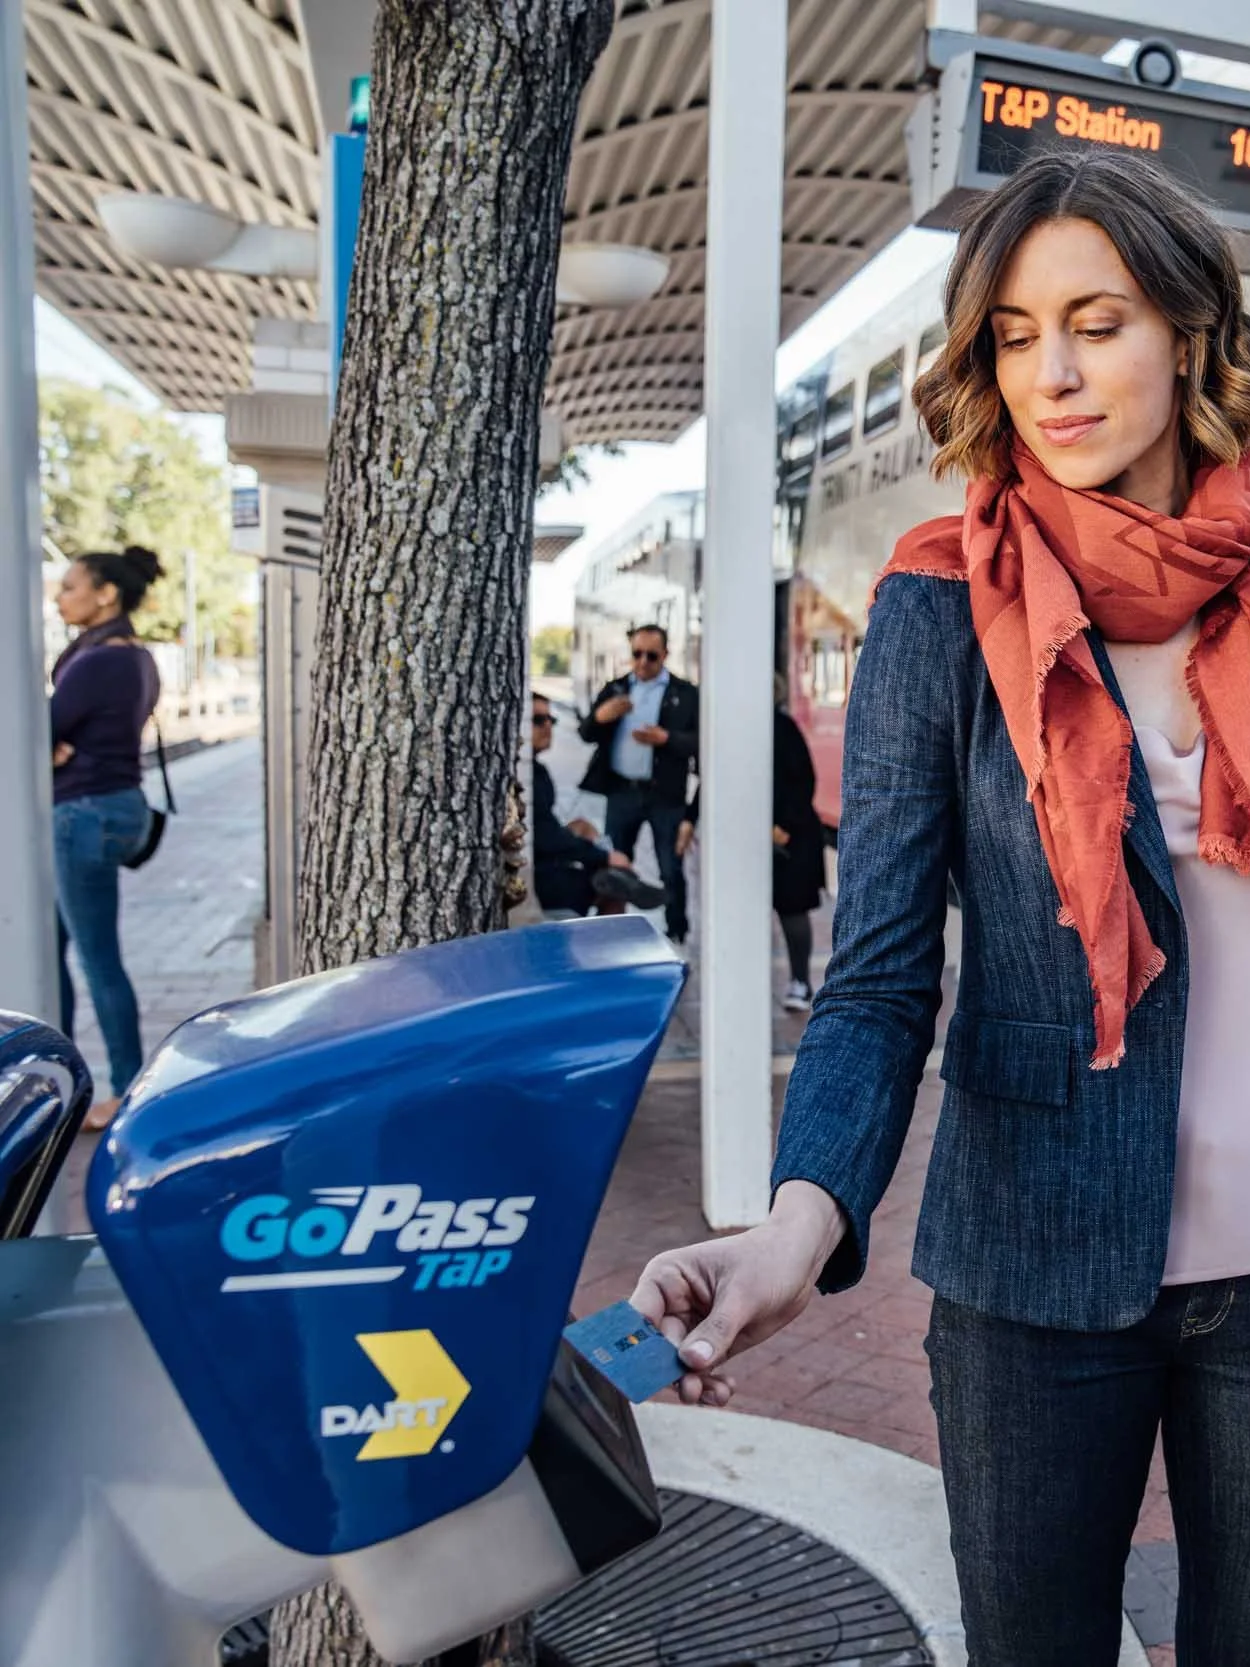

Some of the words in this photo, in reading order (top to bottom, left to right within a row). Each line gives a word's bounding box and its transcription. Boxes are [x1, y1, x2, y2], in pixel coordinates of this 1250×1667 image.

[981, 82, 1049, 130] T&P
[1055, 96, 1162, 151] Station
[321, 1397, 448, 1437] DART
